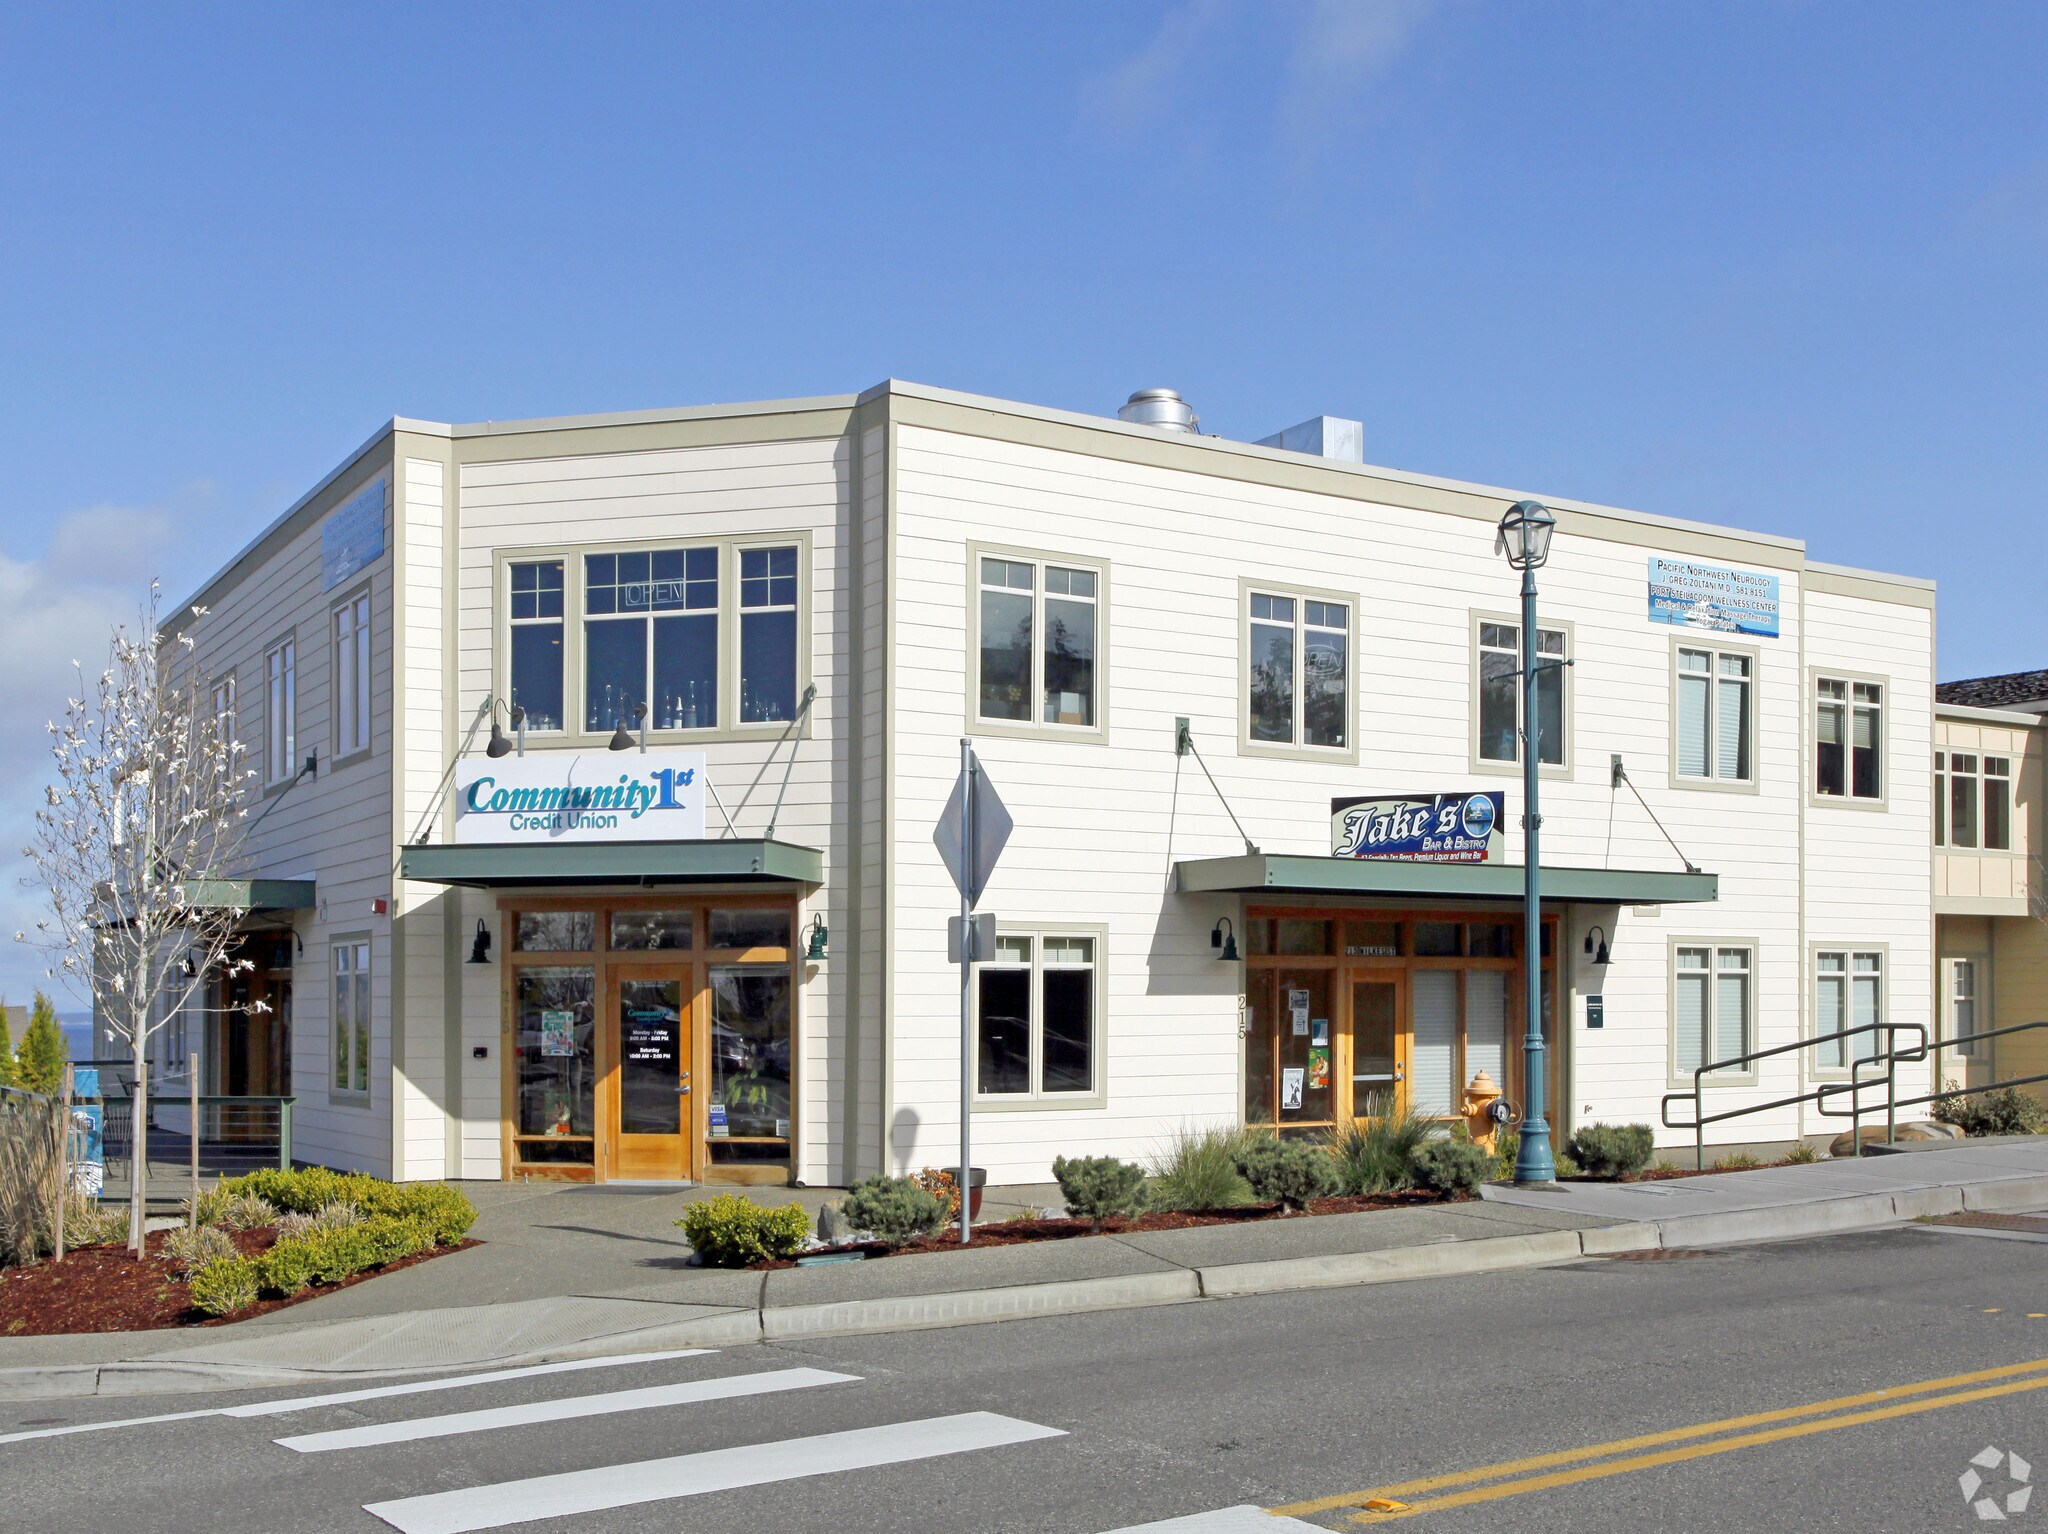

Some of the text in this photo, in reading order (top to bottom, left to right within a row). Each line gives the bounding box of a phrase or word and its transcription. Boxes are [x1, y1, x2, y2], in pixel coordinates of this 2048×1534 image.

[628, 582, 682, 603] OPEN
[1669, 576, 1688, 586] GREG
[1689, 579, 1717, 589] ZOLTANI
[1651, 586, 1776, 612] PORT STEILACOOM WELLNESS CENTER
[1655, 599, 1680, 611] Medical
[1688, 604, 1720, 616] Relaxation
[1721, 609, 1747, 621] Massage
[1748, 612, 1771, 624] Therapy
[468, 768, 695, 818] Community 1st
[510, 812, 617, 830] Credit Union
[1333, 795, 1461, 856] Jake's
[1443, 837, 1453, 849] &
[1434, 853, 1449, 861] Liquor
[1472, 851, 1482, 859] Bar
[1238, 996, 1246, 1039] 215
